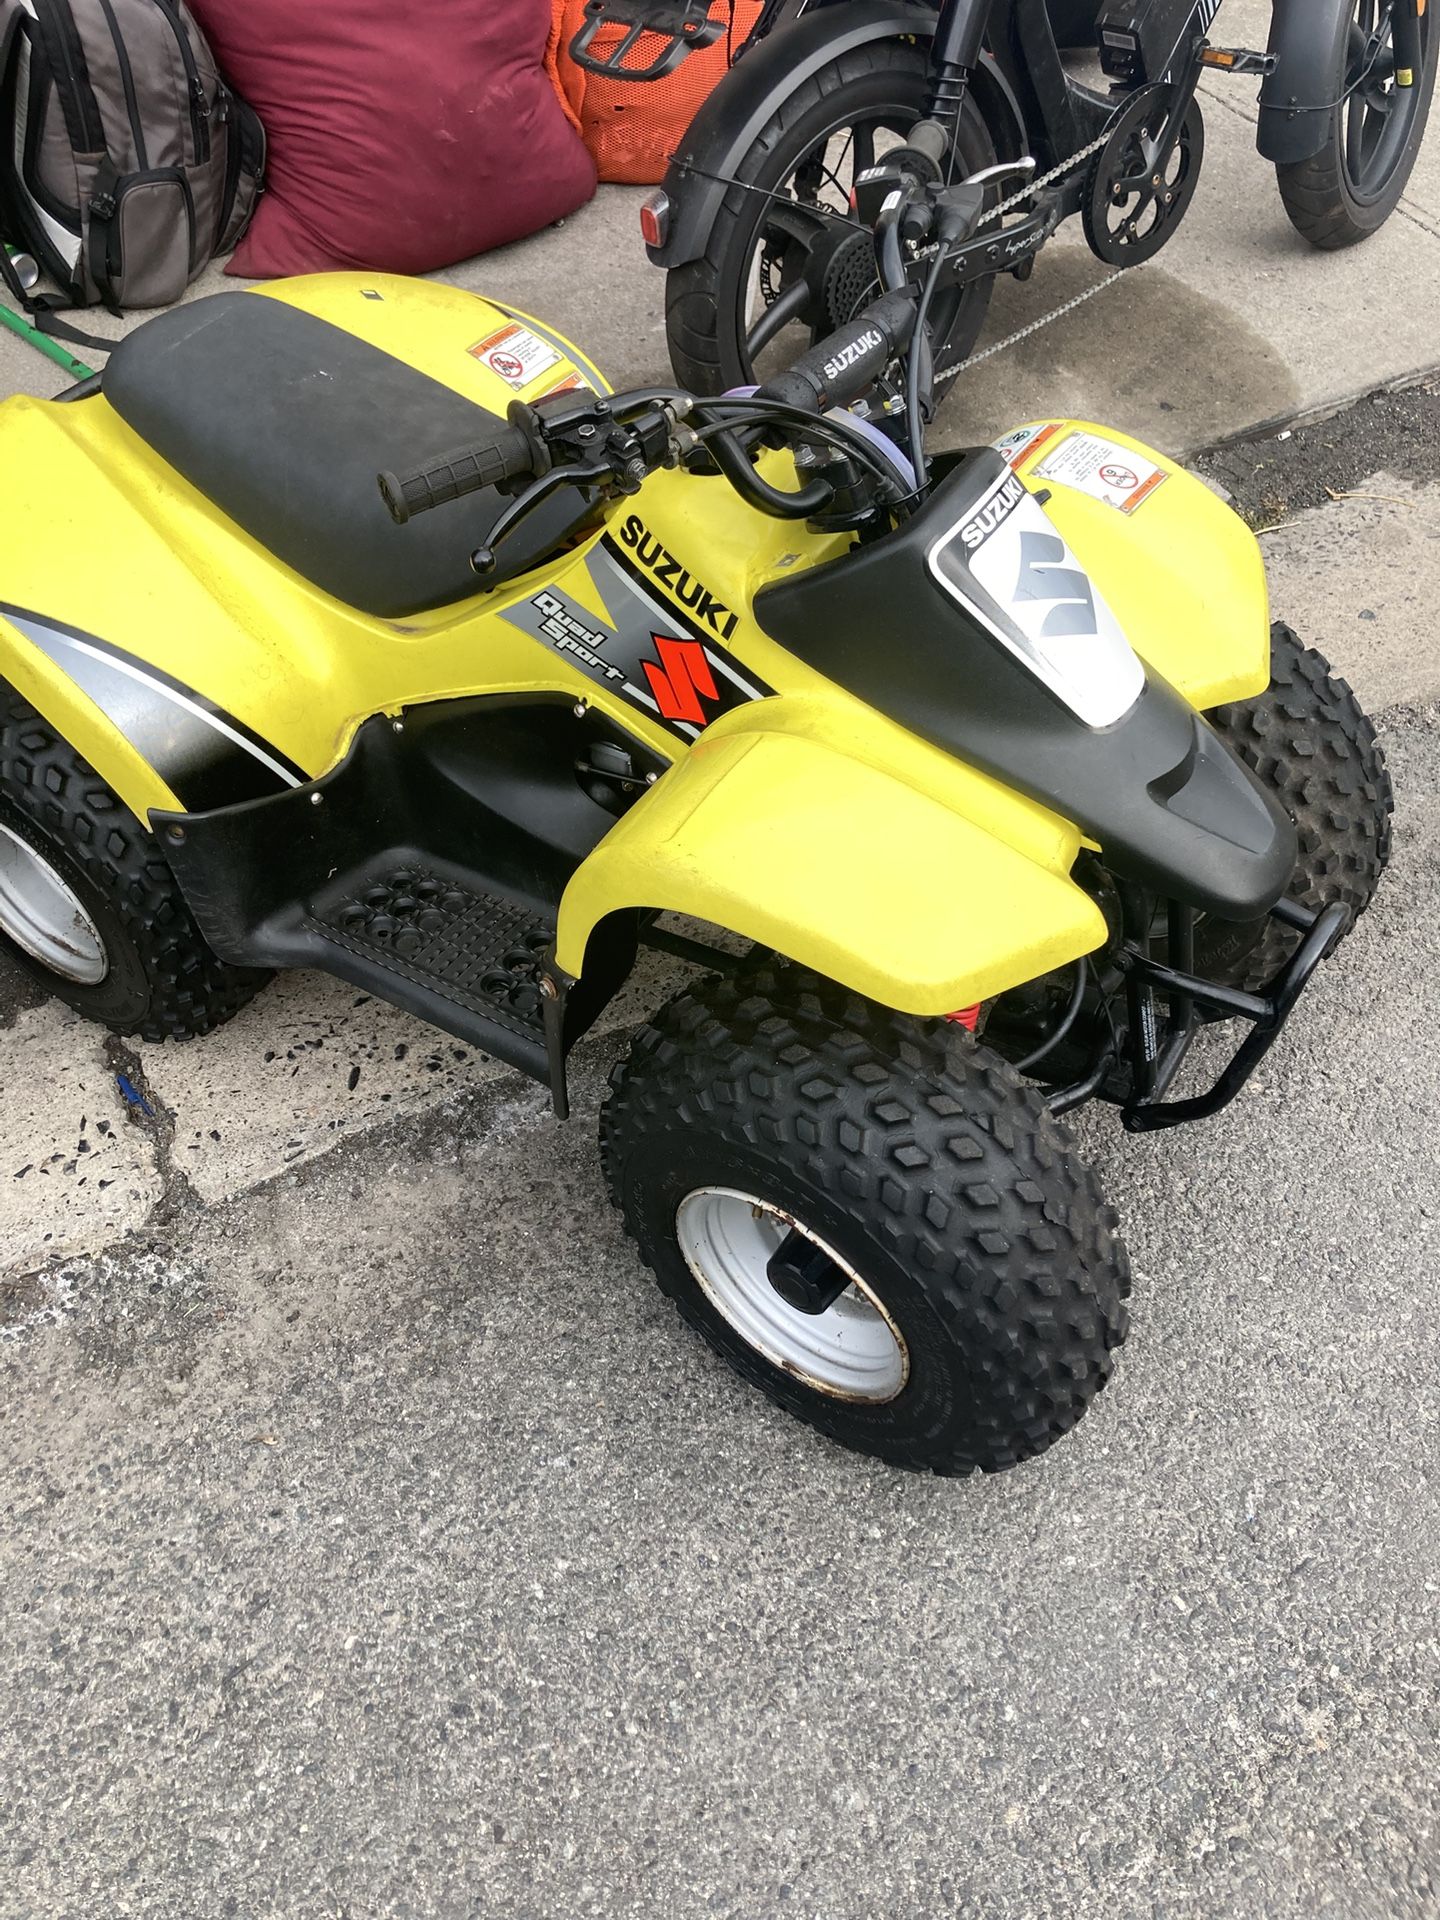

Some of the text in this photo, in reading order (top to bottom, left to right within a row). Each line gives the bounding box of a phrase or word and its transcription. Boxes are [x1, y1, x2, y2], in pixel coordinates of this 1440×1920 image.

[823, 330, 883, 380] SUZUKI
[961, 475, 1024, 549] SUZUKI
[620, 515, 739, 641] SUZUKI
[531, 591, 609, 650] Quad
[538, 617, 628, 681] Sport
